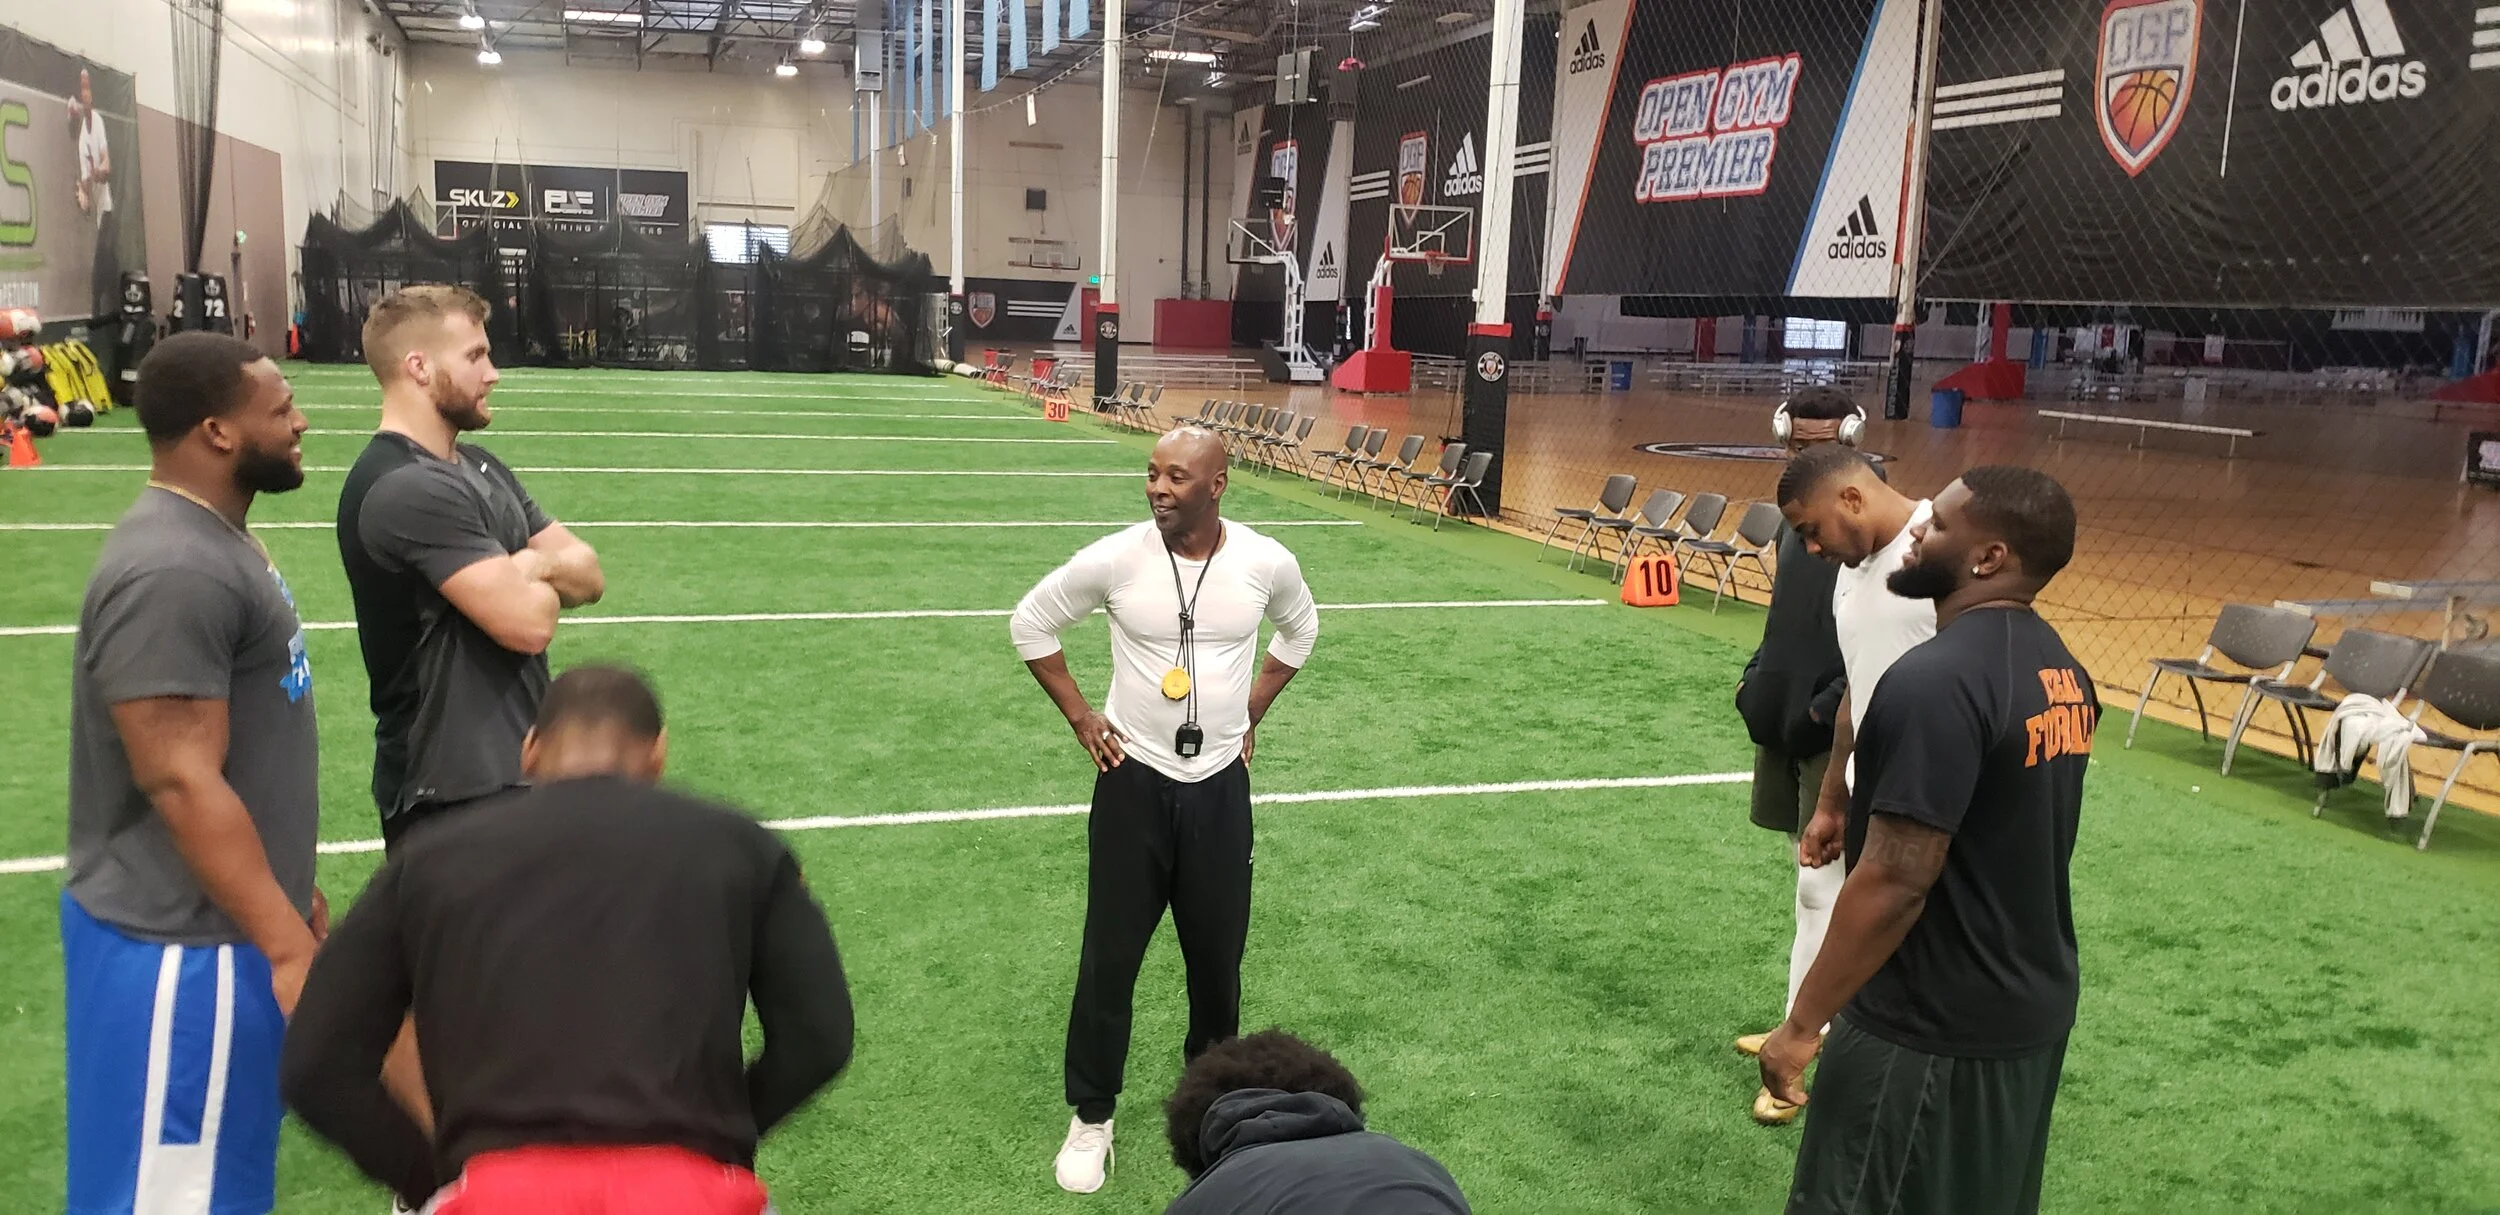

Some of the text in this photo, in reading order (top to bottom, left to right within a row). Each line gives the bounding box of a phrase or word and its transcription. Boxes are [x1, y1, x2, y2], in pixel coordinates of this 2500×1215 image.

[1569, 51, 1606, 75] adidas
[2270, 56, 2427, 112] adidas
[1635, 56, 1800, 141] OPEN GYM
[1635, 128, 1775, 200] PREMIER
[1444, 171, 1483, 197] adidas
[449, 188, 506, 208] SKLZ
[1828, 236, 1887, 260] adidas
[1316, 266, 1338, 280] adidas
[203, 299, 225, 318] 72
[1048, 401, 1066, 418] 30
[1640, 559, 1673, 597] 10
